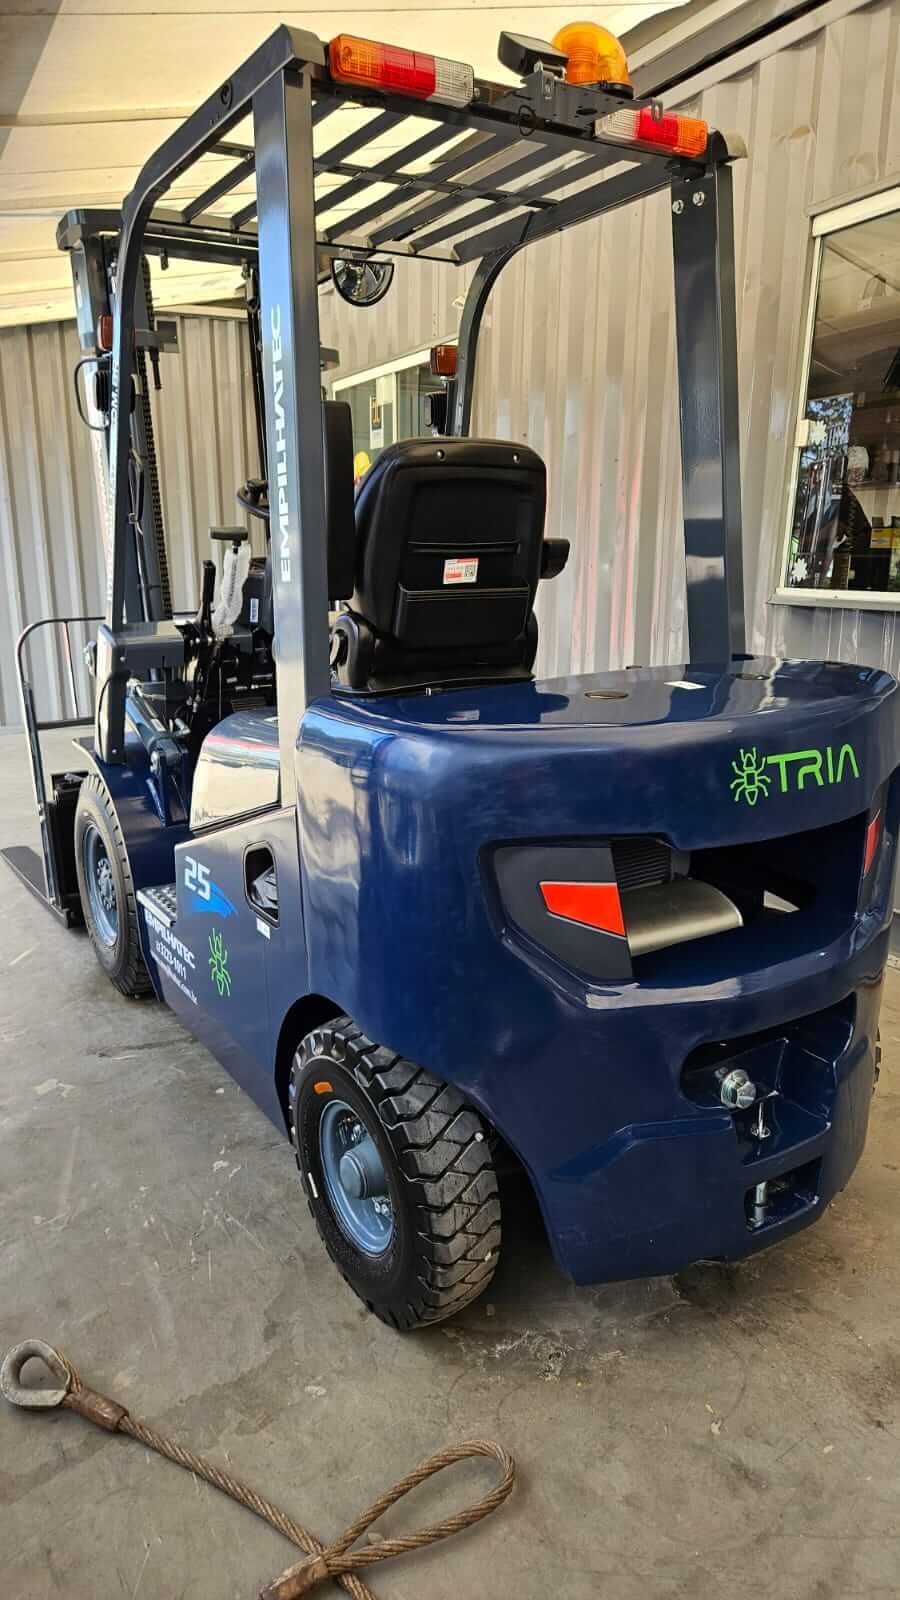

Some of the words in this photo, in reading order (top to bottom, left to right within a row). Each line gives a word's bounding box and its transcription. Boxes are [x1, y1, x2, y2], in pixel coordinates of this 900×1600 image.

[271, 304, 292, 583] EMPILHATEC
[767, 743, 860, 792] TRIA
[184, 855, 211, 901] 25
